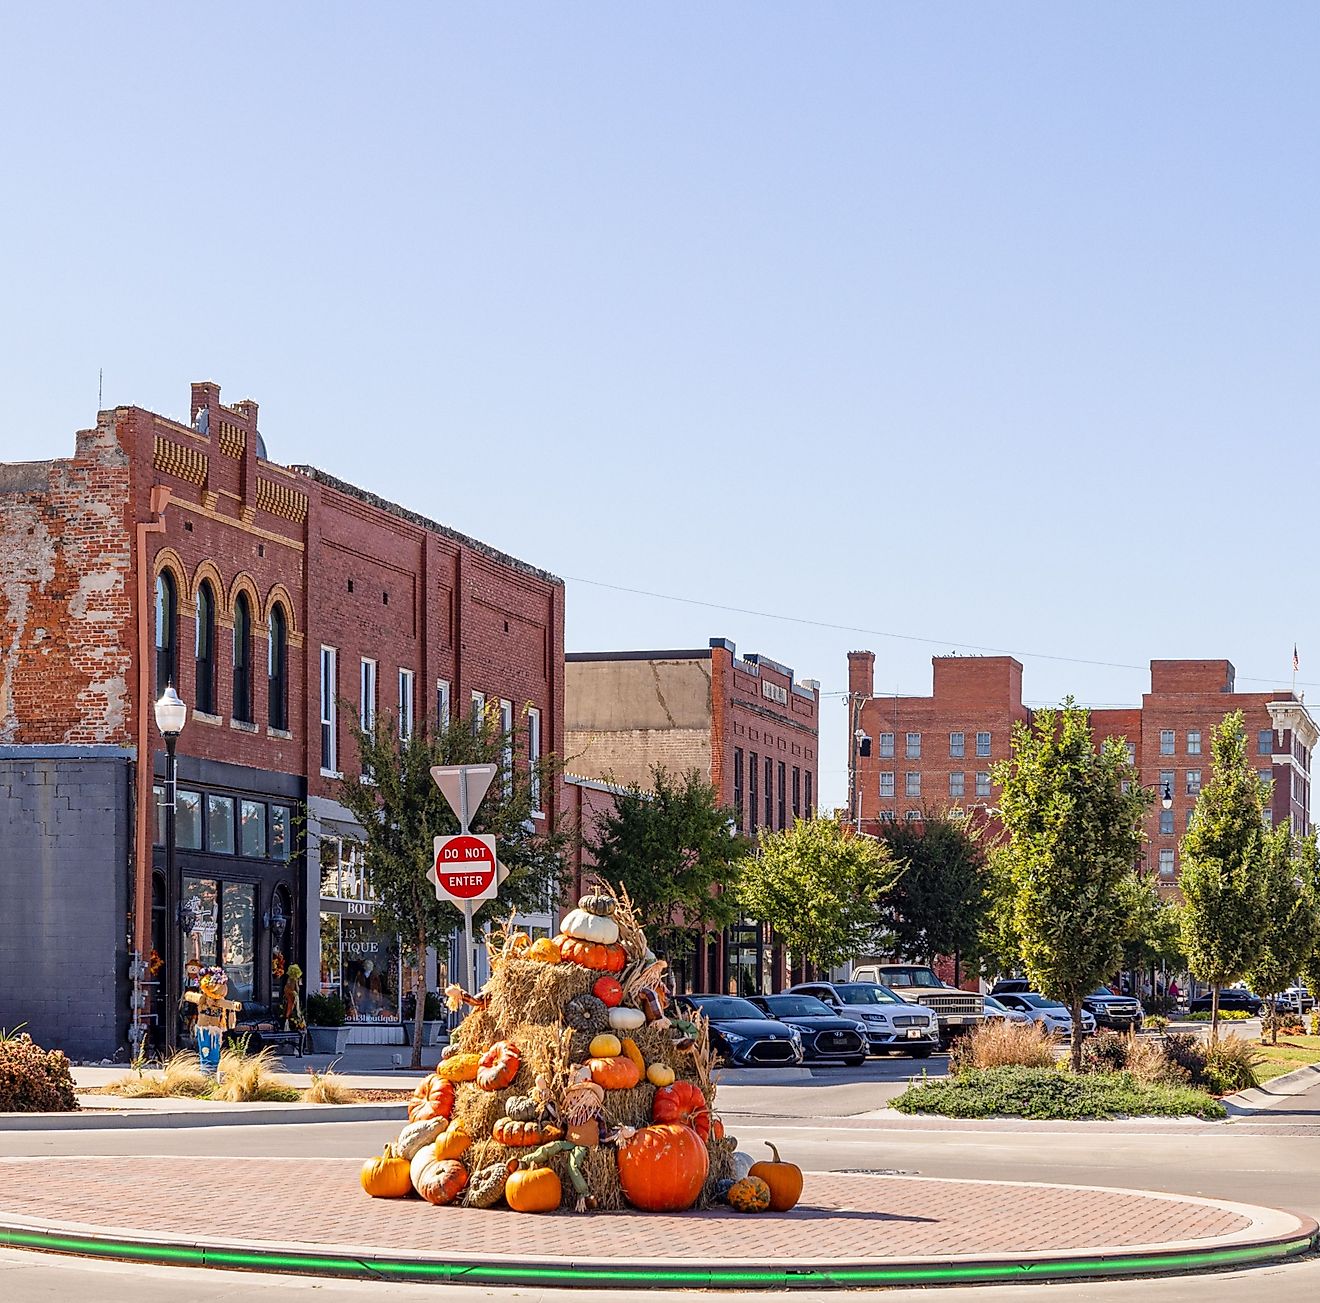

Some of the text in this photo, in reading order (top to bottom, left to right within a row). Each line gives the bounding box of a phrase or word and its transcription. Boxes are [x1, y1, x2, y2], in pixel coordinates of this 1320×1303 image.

[444, 848, 486, 859] DO NOT
[449, 876, 483, 886] ENTER
